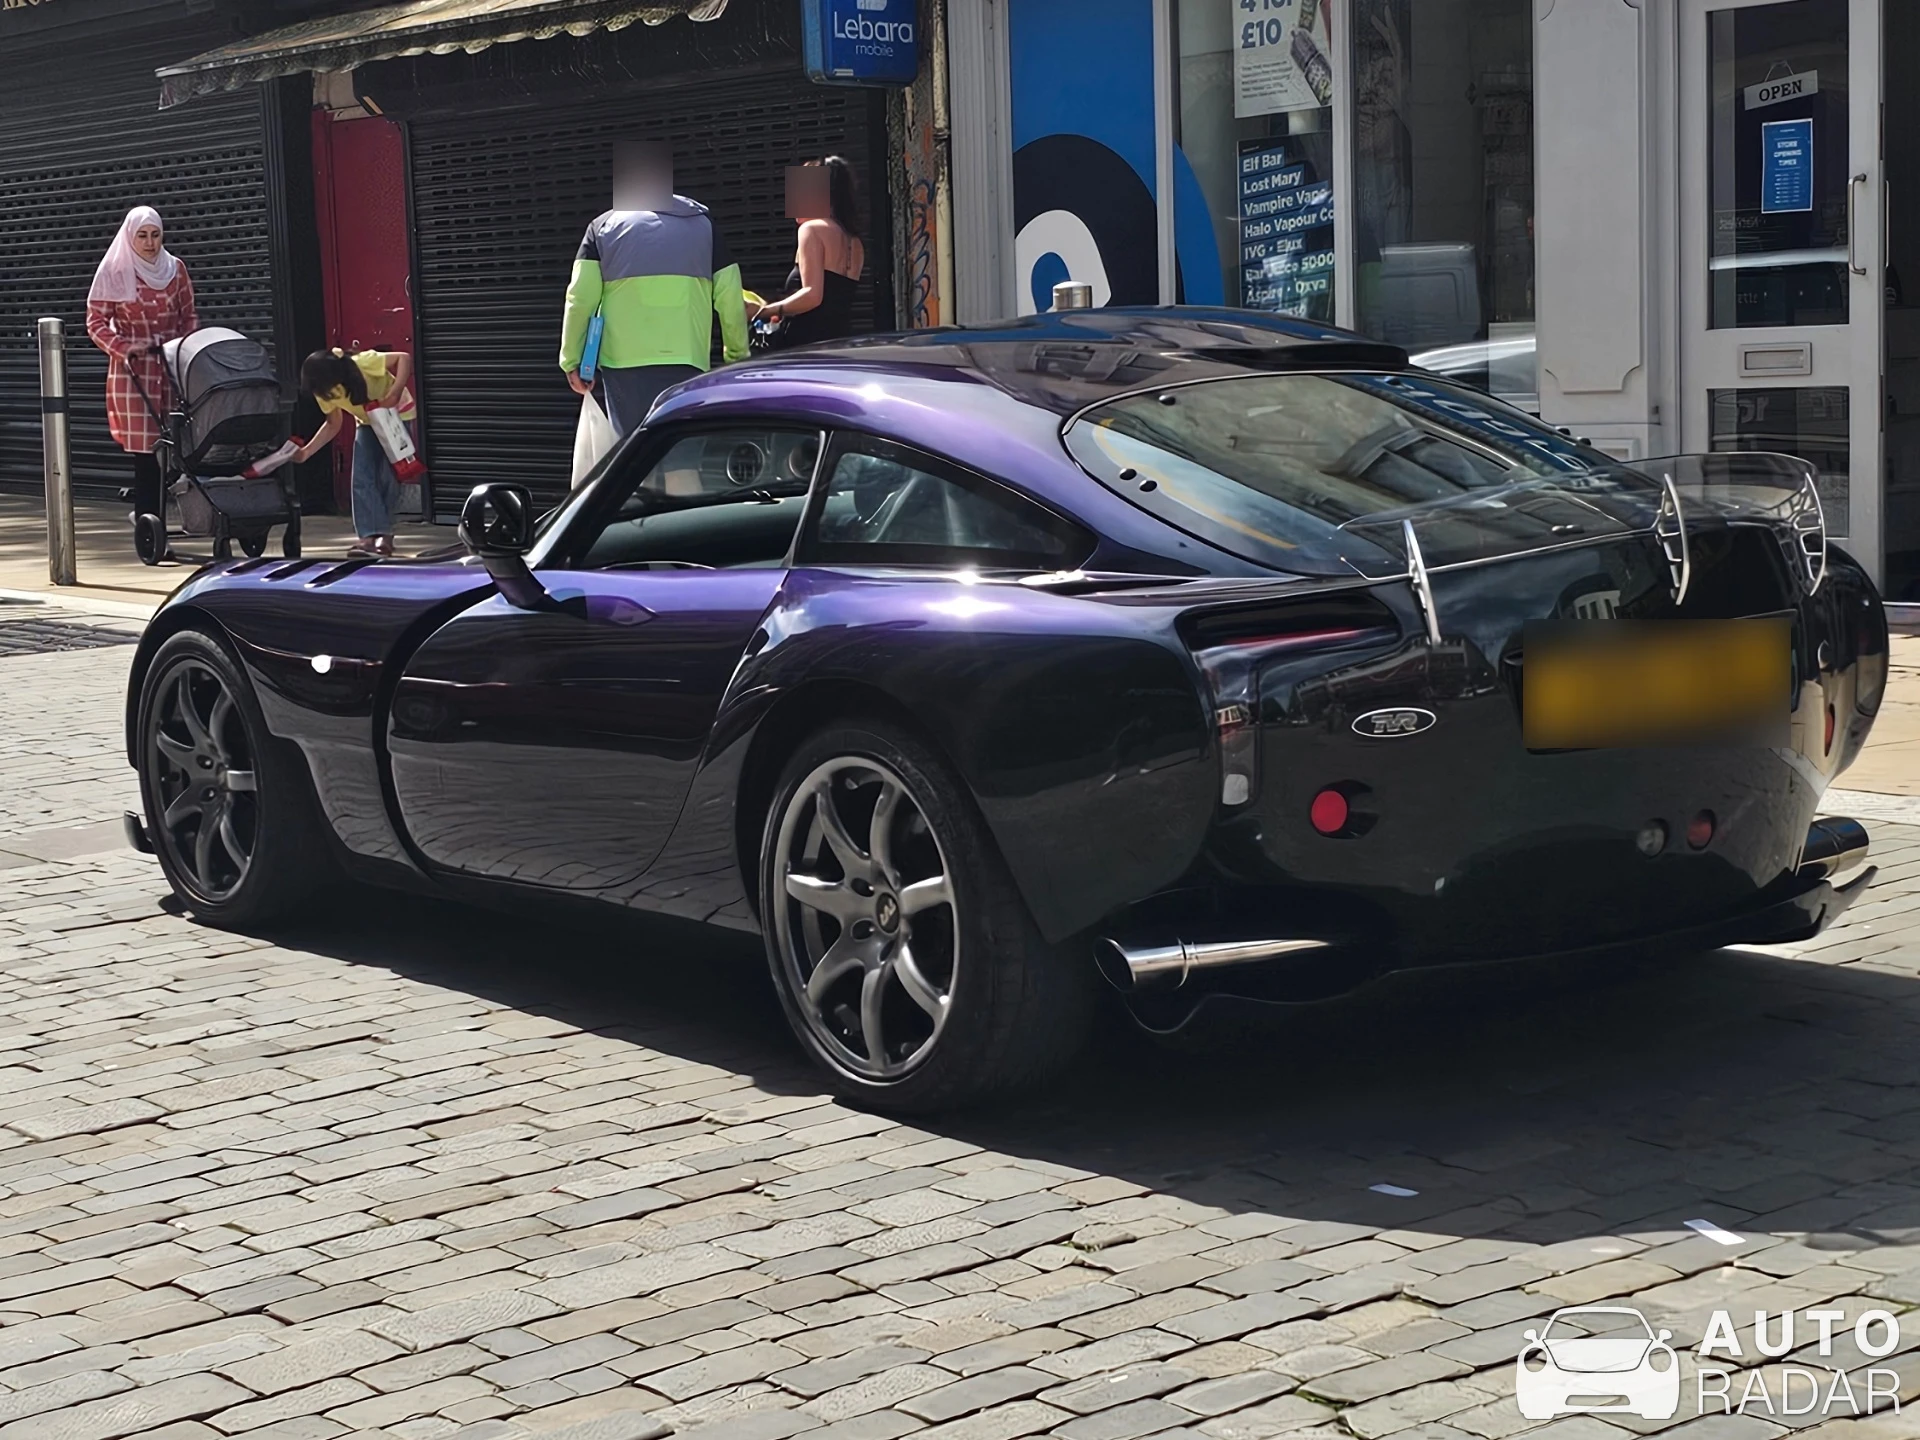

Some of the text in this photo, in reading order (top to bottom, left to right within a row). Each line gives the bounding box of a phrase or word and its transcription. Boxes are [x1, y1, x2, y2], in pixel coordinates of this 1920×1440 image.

[834, 11, 913, 43] Lebara
[1241, 18, 1282, 49] £10
[855, 43, 893, 57] mobile
[1758, 80, 1802, 101] OPEN
[1242, 153, 1282, 173] Elf Bar
[1243, 171, 1301, 194] Lost Mary
[1244, 195, 1293, 217] Vampire
[1245, 222, 1271, 238] Halo
[1274, 213, 1317, 232] Vapour
[1245, 244, 1266, 260] IVG
[1301, 252, 1335, 271] 5000
[1371, 712, 1417, 734] TVR
